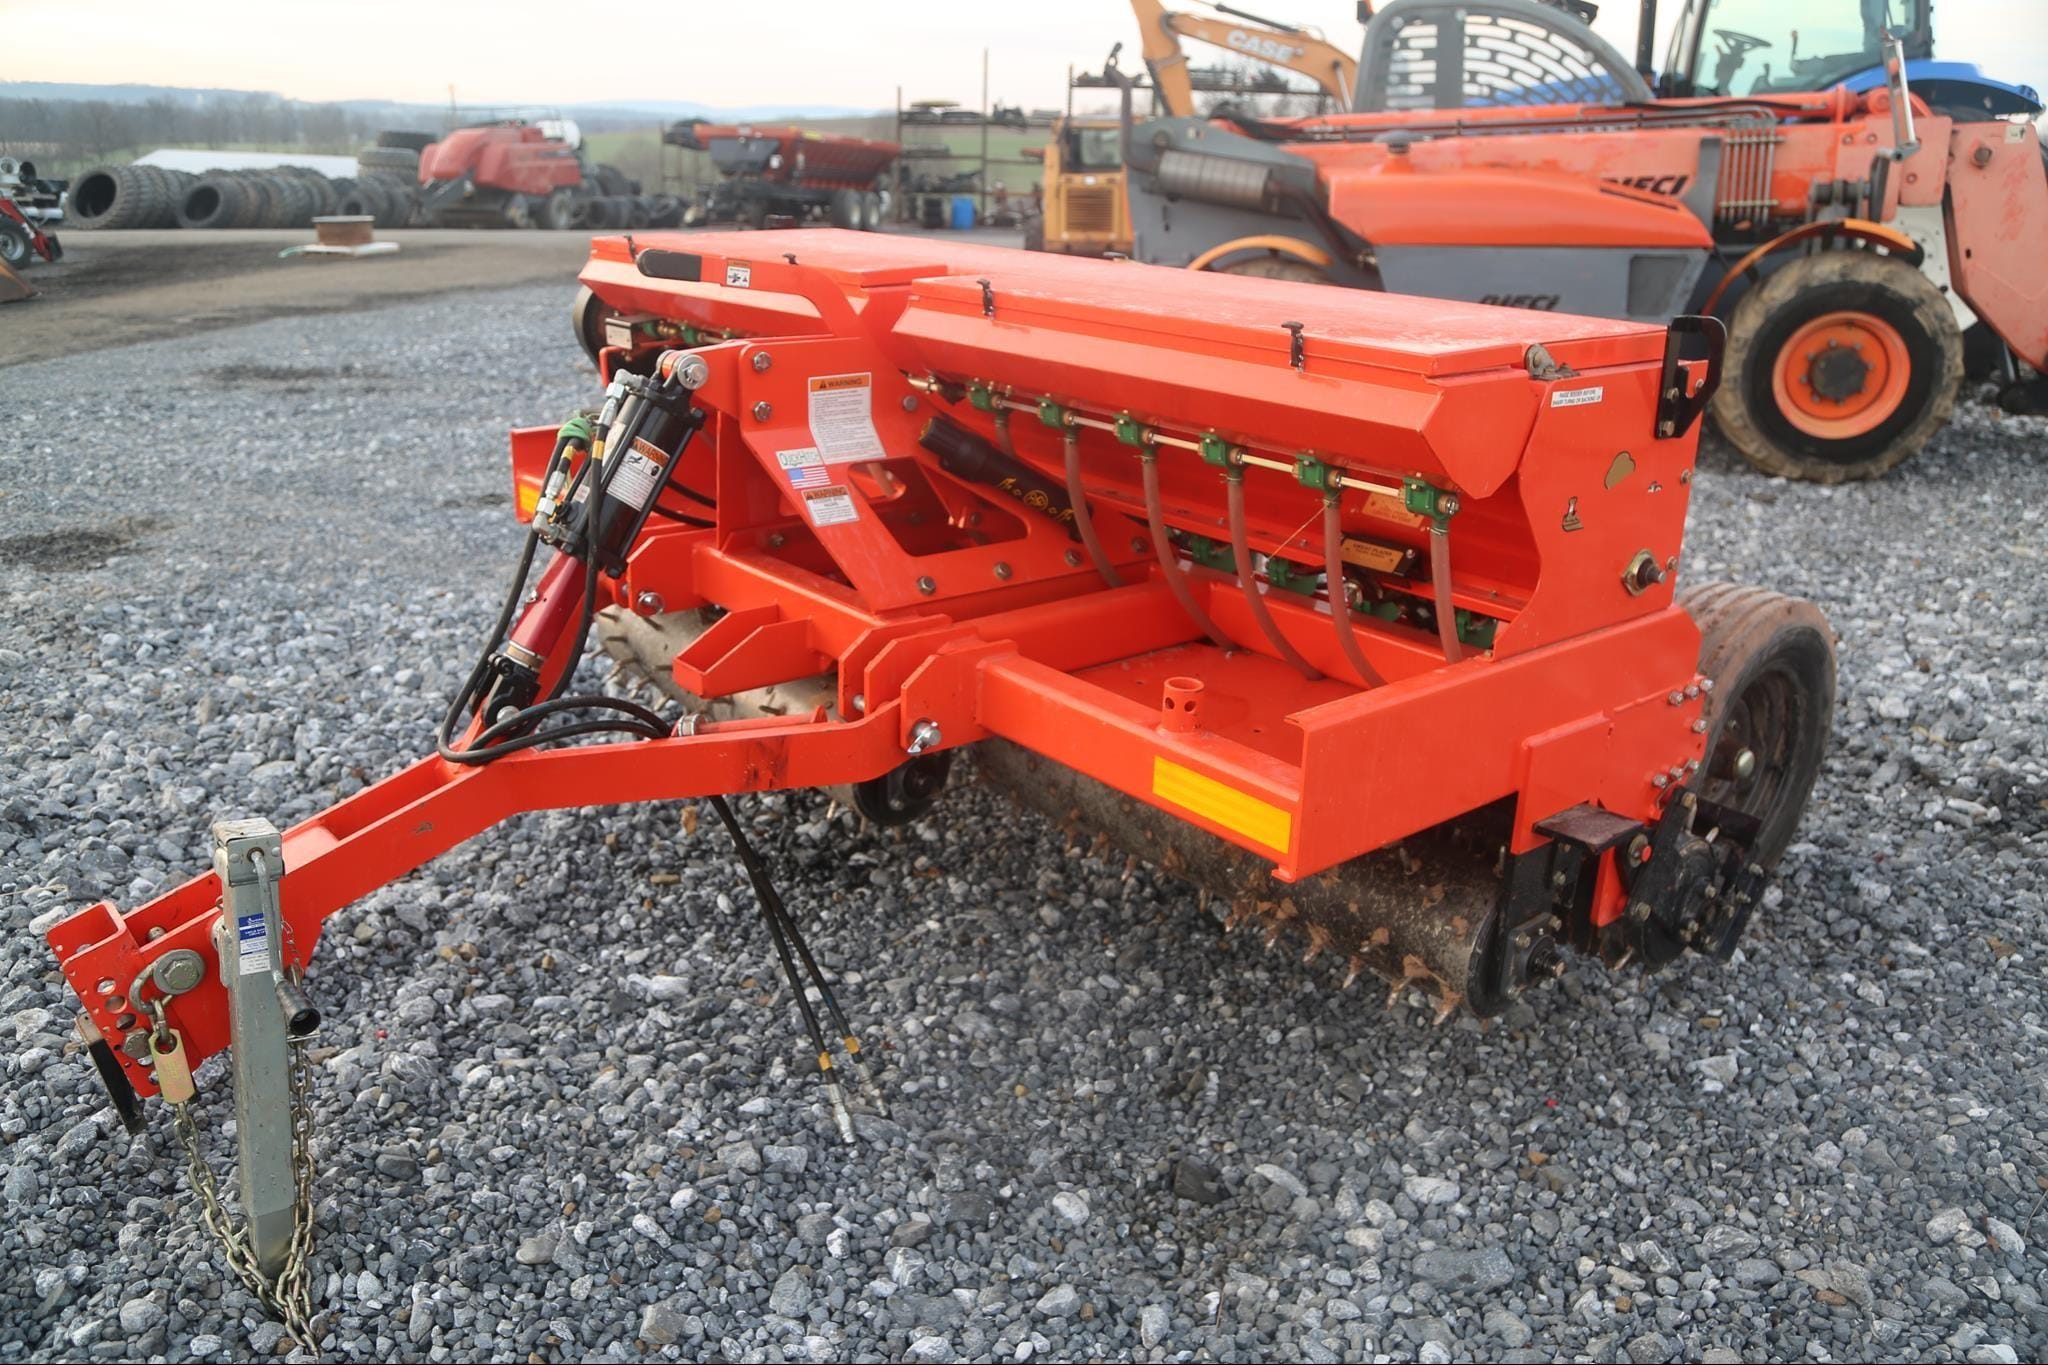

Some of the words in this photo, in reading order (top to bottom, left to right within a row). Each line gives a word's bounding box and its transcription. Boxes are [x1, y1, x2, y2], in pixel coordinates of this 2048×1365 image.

[1227, 29, 1294, 61] CASE
[828, 378, 863, 388] WARNING
[812, 486, 848, 499] WARNING
